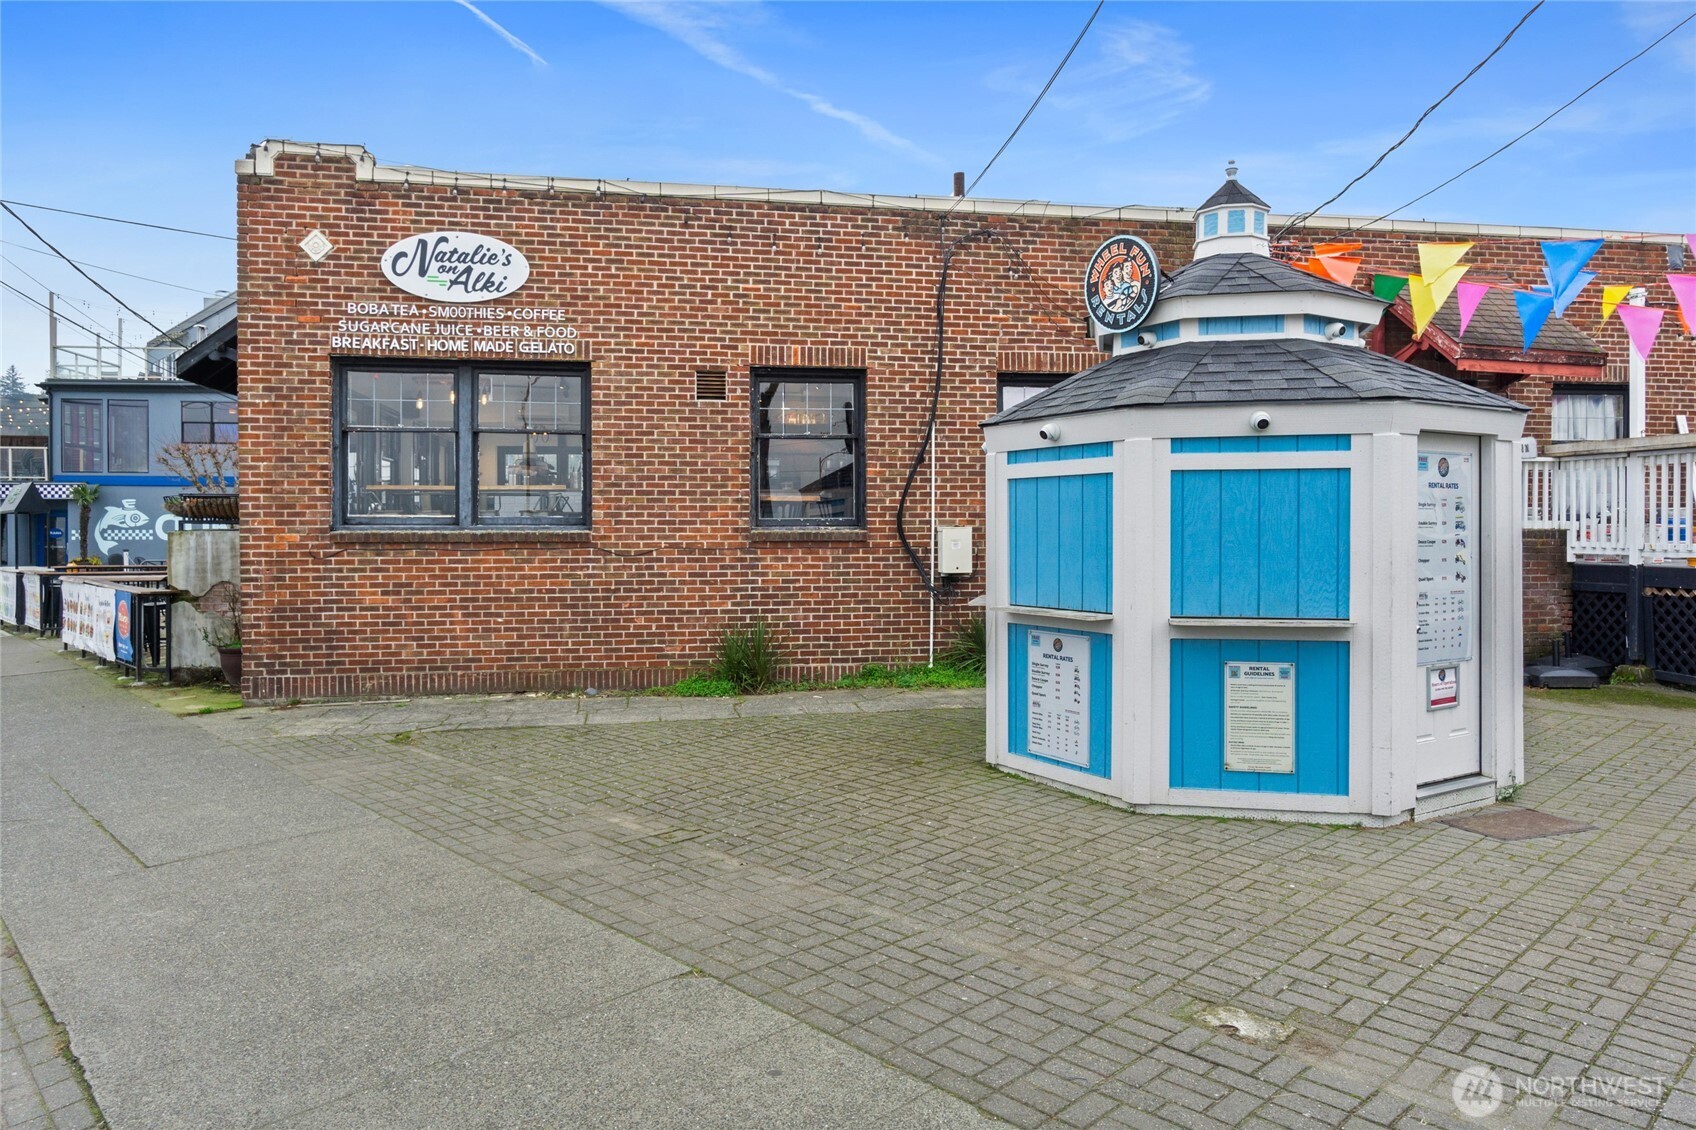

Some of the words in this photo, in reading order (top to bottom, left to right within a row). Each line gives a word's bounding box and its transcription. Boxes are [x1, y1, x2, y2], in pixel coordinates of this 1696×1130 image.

[391, 236, 512, 278] Natalie's
[1090, 243, 1127, 283] WHEEL
[1129, 245, 1151, 277] FUN
[437, 264, 460, 275] on
[447, 265, 508, 294] Alki
[347, 302, 389, 316] BOBA
[391, 304, 419, 317] TEA
[428, 306, 504, 320] SMOOTHIES
[513, 308, 566, 321] COFFEE
[1091, 288, 1148, 325] RENTALS
[338, 320, 431, 335] SUGARCANE
[434, 324, 473, 337] JUICE
[483, 325, 519, 338] BEER
[523, 326, 534, 338] &
[536, 326, 577, 339] FOOD
[332, 337, 418, 350] BREAKFAST
[427, 339, 469, 352] HOME
[474, 341, 514, 353] MADE
[519, 342, 576, 355] GELATO
[1043, 653, 1060, 661] RENTAL
